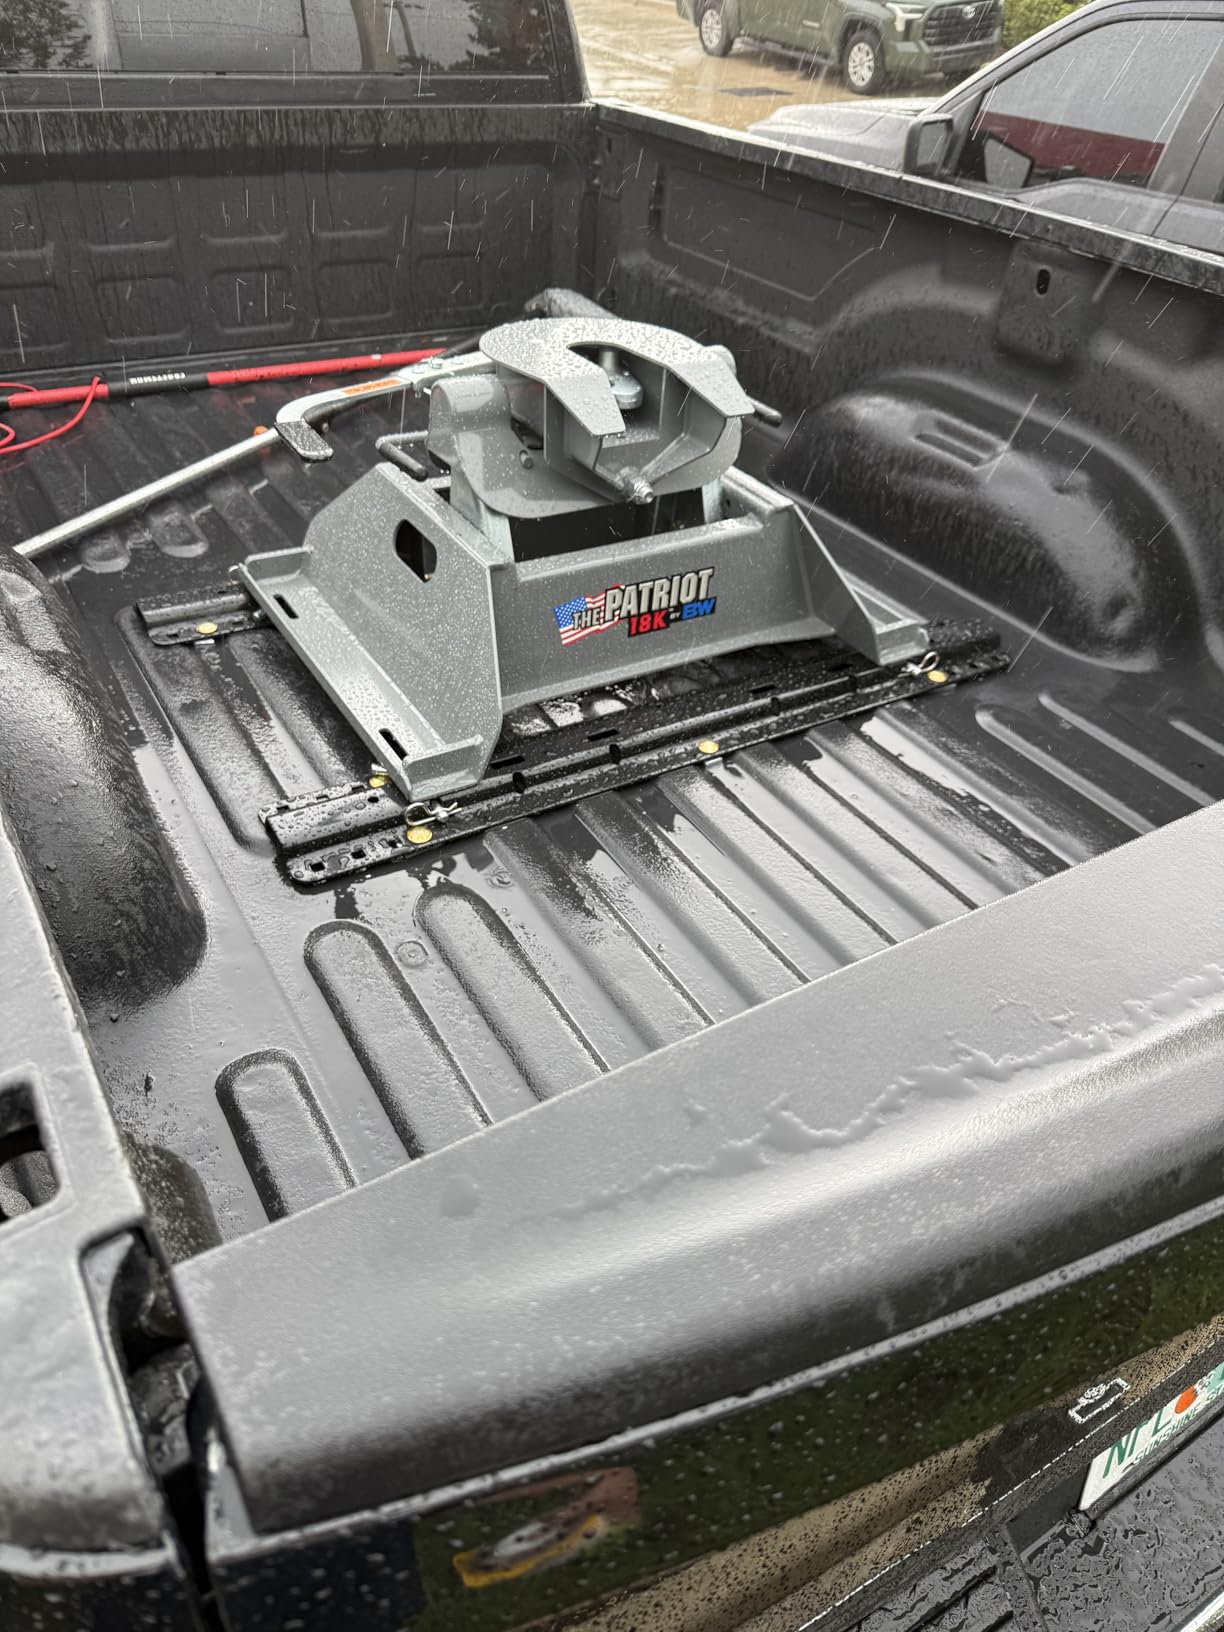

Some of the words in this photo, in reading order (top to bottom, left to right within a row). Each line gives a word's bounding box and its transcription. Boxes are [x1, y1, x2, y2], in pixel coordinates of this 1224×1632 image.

[573, 606, 601, 630] THE
[605, 567, 715, 621] PATRIOT
[629, 610, 668, 636] 18K
[682, 598, 716, 621] BW
